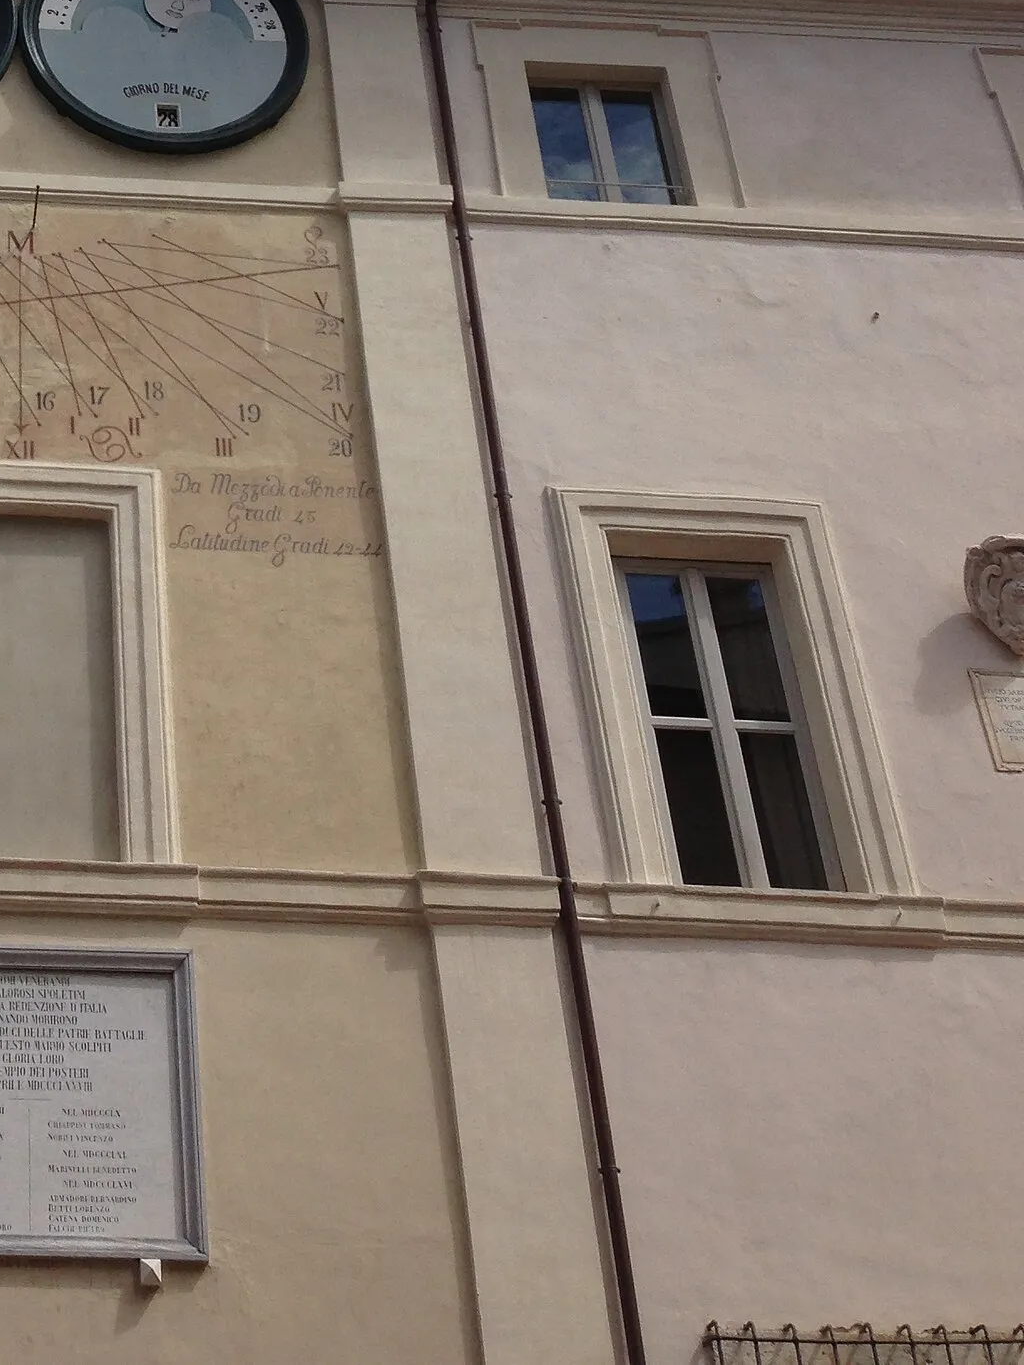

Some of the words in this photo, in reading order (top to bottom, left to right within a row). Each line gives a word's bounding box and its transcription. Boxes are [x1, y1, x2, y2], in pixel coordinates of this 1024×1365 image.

[47, 9, 59, 17] 2
[254, 2, 268, 13] 26
[123, 83, 160, 99] GIORNO
[163, 83, 179, 95] DEL
[182, 84, 210, 102] MESE
[157, 109, 179, 128] 28
[7, 230, 35, 254] M
[313, 291, 328, 310] V
[144, 381, 164, 401] 18
[321, 374, 341, 392] 21
[36, 391, 56, 411] 16
[90, 386, 110, 405] 17
[237, 403, 261, 423] 19
[331, 402, 354, 422] IV
[5, 439, 35, 459] XII
[215, 437, 234, 457] III
[328, 438, 352, 458] 20
[171, 472, 202, 496] Da
[301, 474, 376, 500] Ponente
[225, 501, 282, 534] Gradi
[169, 525, 271, 554] Latitudine
[271, 534, 329, 567] Gradi
[38, 989, 85, 1000] SPOLETINI
[9, 1001, 65, 1012] REDENZIONE
[31, 1015, 77, 1025] MORIRONO
[24, 1027, 55, 1038] DELLE
[58, 1028, 90, 1039] PATRIE
[95, 1029, 147, 1041] BATTAGLIE
[34, 1041, 65, 1052] MARMO
[69, 1042, 111, 1053] SCOLPITI
[2, 1053, 36, 1064] GLORIA
[39, 1054, 64, 1065] LORO
[30, 1067, 45, 1078] DEI
[48, 1067, 89, 1078] POSTERI
[62, 1108, 78, 1117] NEL
[62, 1149, 78, 1158] NEL
